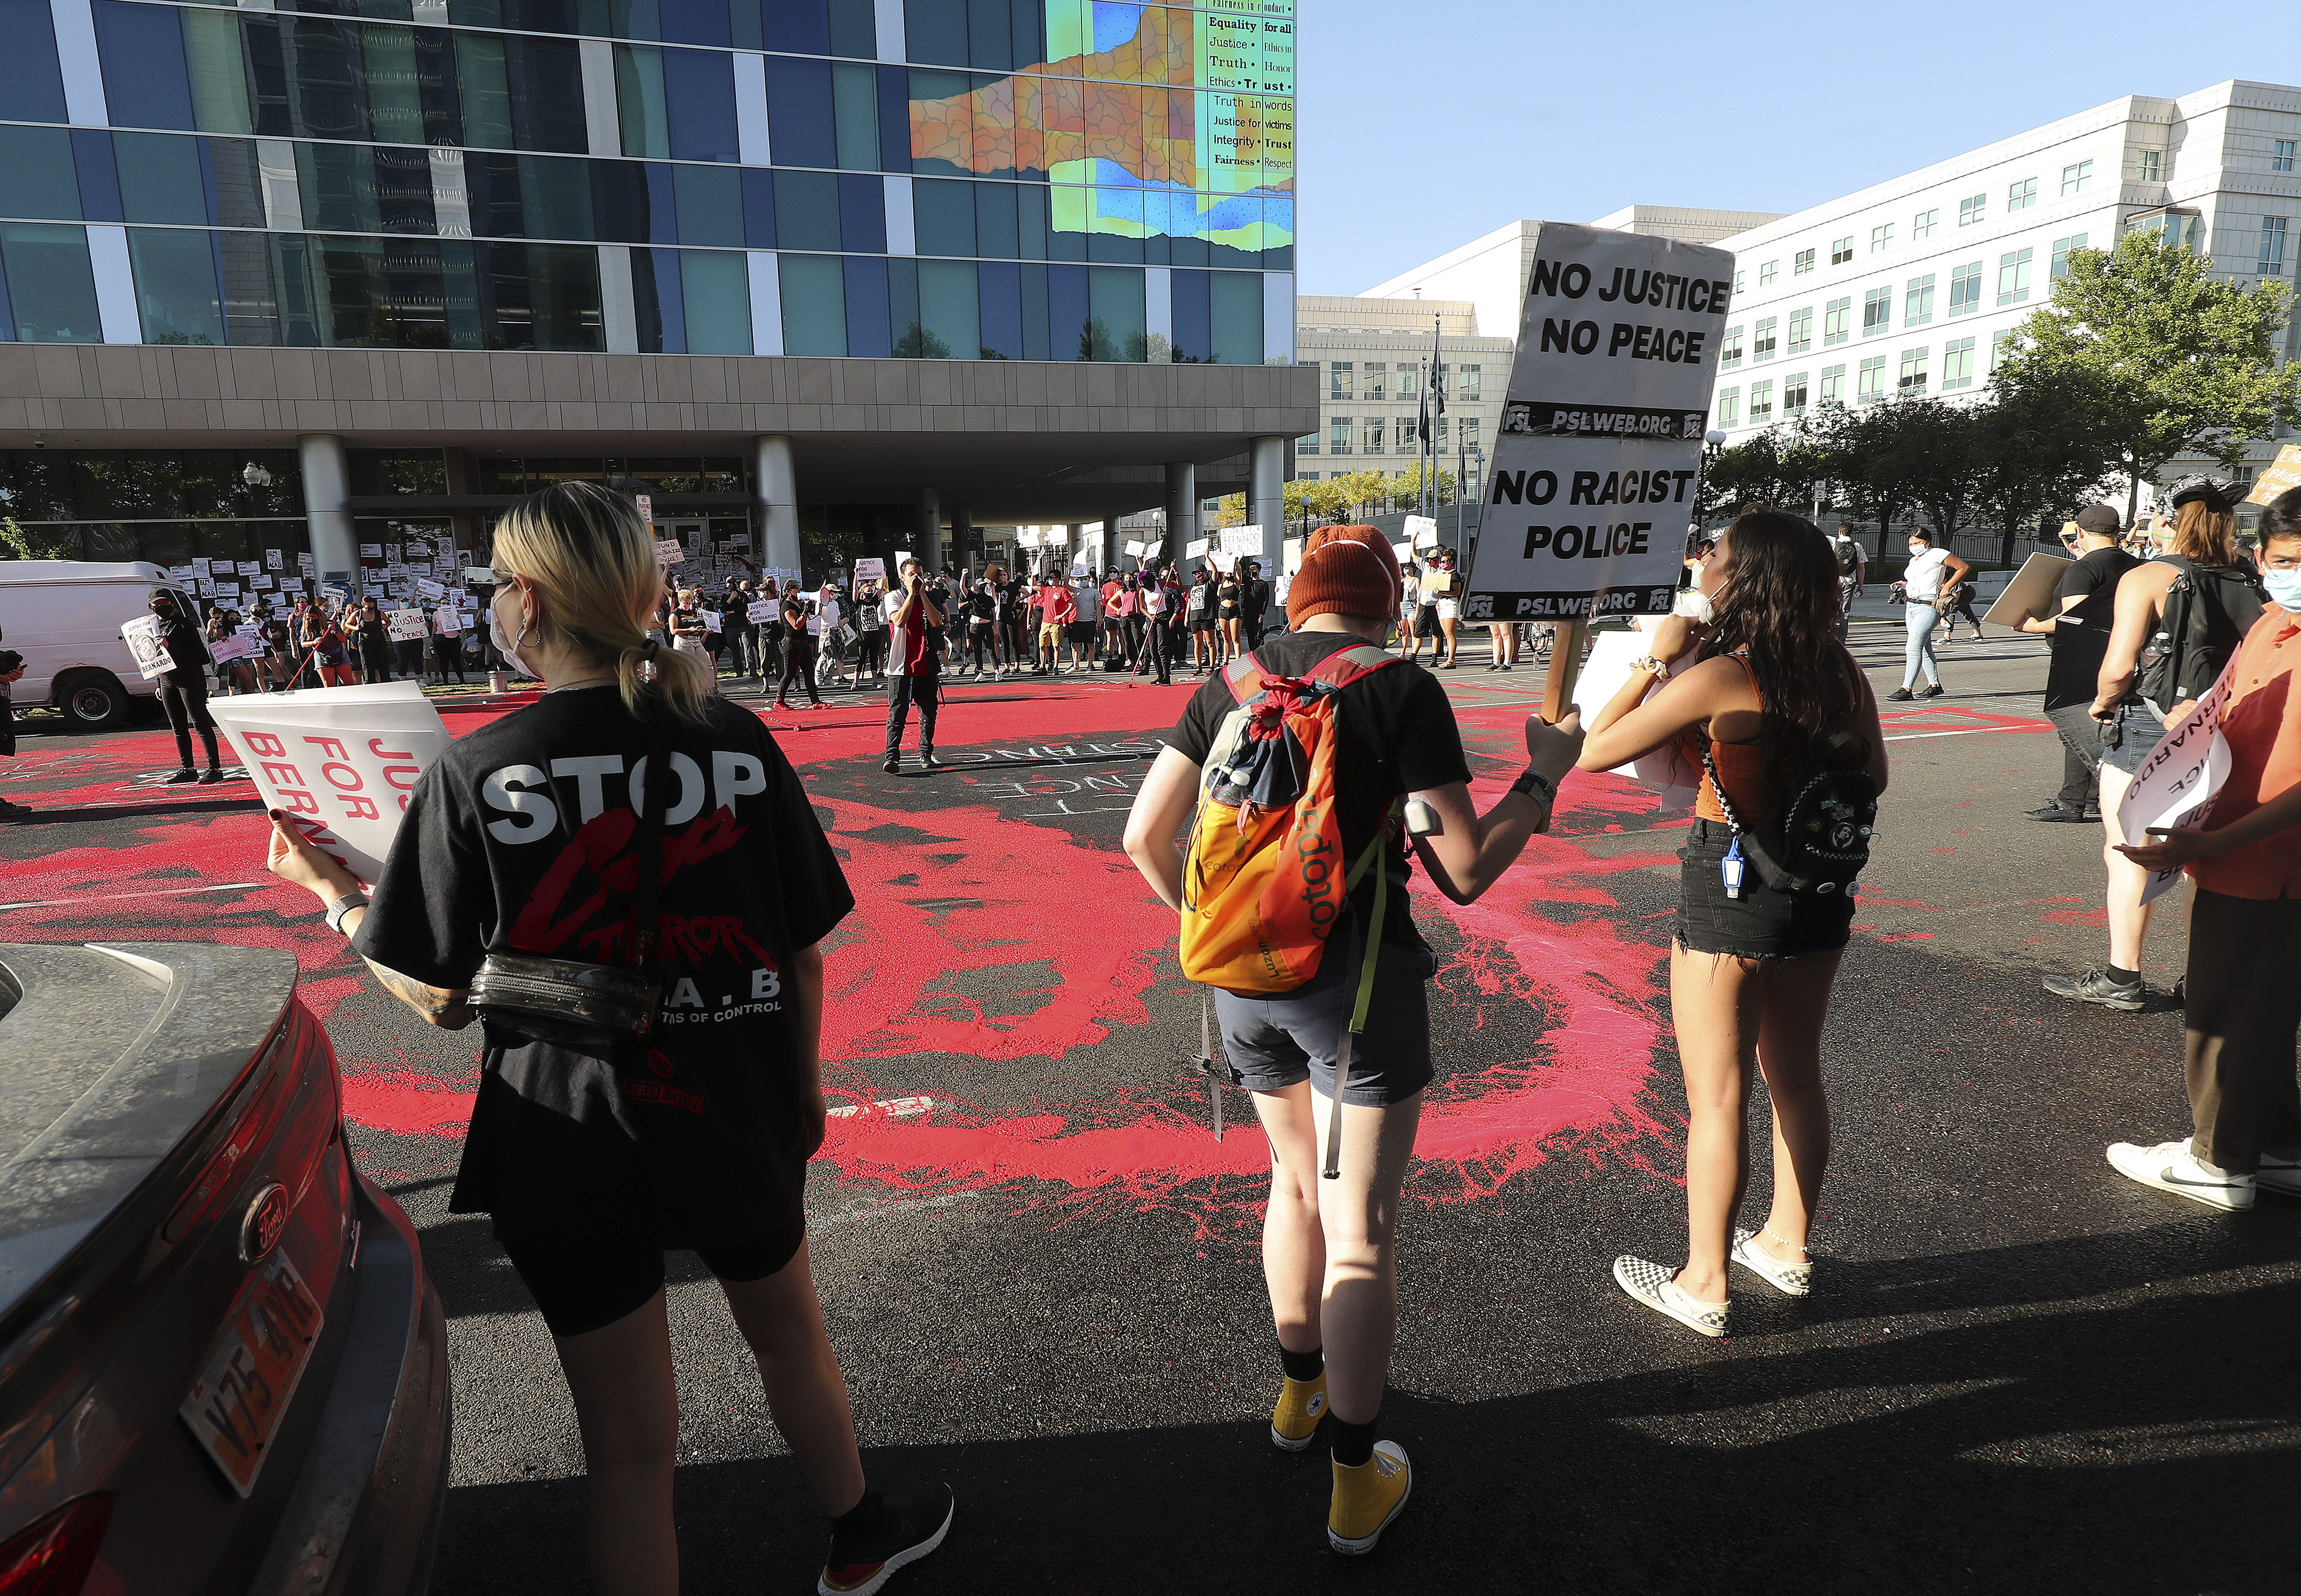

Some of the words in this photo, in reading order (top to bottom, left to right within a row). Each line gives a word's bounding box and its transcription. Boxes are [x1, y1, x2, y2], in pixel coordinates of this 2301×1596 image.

[1248, 0, 1254, 11] in
[1209, 16, 1257, 33] Equality
[1264, 22, 1278, 32] for
[1280, 24, 1292, 34] all
[1209, 36, 1248, 49] Justice
[1264, 42, 1284, 53] Ethics
[1285, 44, 1292, 53] in
[1209, 56, 1247, 69] Truth
[1264, 61, 1292, 73] Honor
[1209, 76, 1235, 88] Ethics
[1244, 79, 1284, 91] Trust
[1214, 95, 1244, 107] Truth
[1250, 98, 1261, 109] in
[1264, 100, 1292, 111] words
[1214, 116, 1245, 127] Justice
[1248, 118, 1261, 127] for
[1265, 120, 1292, 130] victims
[1214, 134, 1255, 149] Integrity
[1264, 139, 1292, 149] Trust
[1214, 154, 1255, 166] Fairness
[1264, 157, 1292, 170] Respect
[1531, 259, 1591, 300] NO
[1598, 267, 1731, 315] JUSTICE
[1540, 318, 1599, 355] NO
[1608, 323, 1706, 365] PEACE
[1504, 412, 1531, 432] PSL
[1552, 410, 1672, 434] PSLWEB.ORG
[1492, 470, 1558, 505] NO
[1569, 470, 1695, 506] RACIST
[1221, 526, 1244, 536] JUSTICE
[1224, 533, 1260, 545] BERNARDO
[1712, 528, 1725, 538] SAY
[1523, 521, 1652, 560] POLICE
[418, 590, 438, 598] BERNARDO
[1465, 601, 1495, 617] PSL
[1648, 593, 1670, 611] PSL
[129, 623, 142, 632] JUSTICE
[393, 614, 424, 627] JUSTICE
[402, 630, 425, 639] PEACE
[211, 638, 231, 649] JUSTICE
[216, 648, 242, 660] BERNARDO
[141, 657, 172, 673] BERNARDO
[2130, 664, 2235, 800] BERNARDO
[302, 736, 380, 821] FOR
[483, 750, 767, 844] STOP
[1257, 941, 1280, 979] Luzon
[689, 1012, 708, 1023] OF
[714, 1001, 782, 1022] CONTROL
[259, 1198, 283, 1249] Ford
[205, 1345, 272, 1458] V75
[259, 1266, 313, 1359] 4YR
